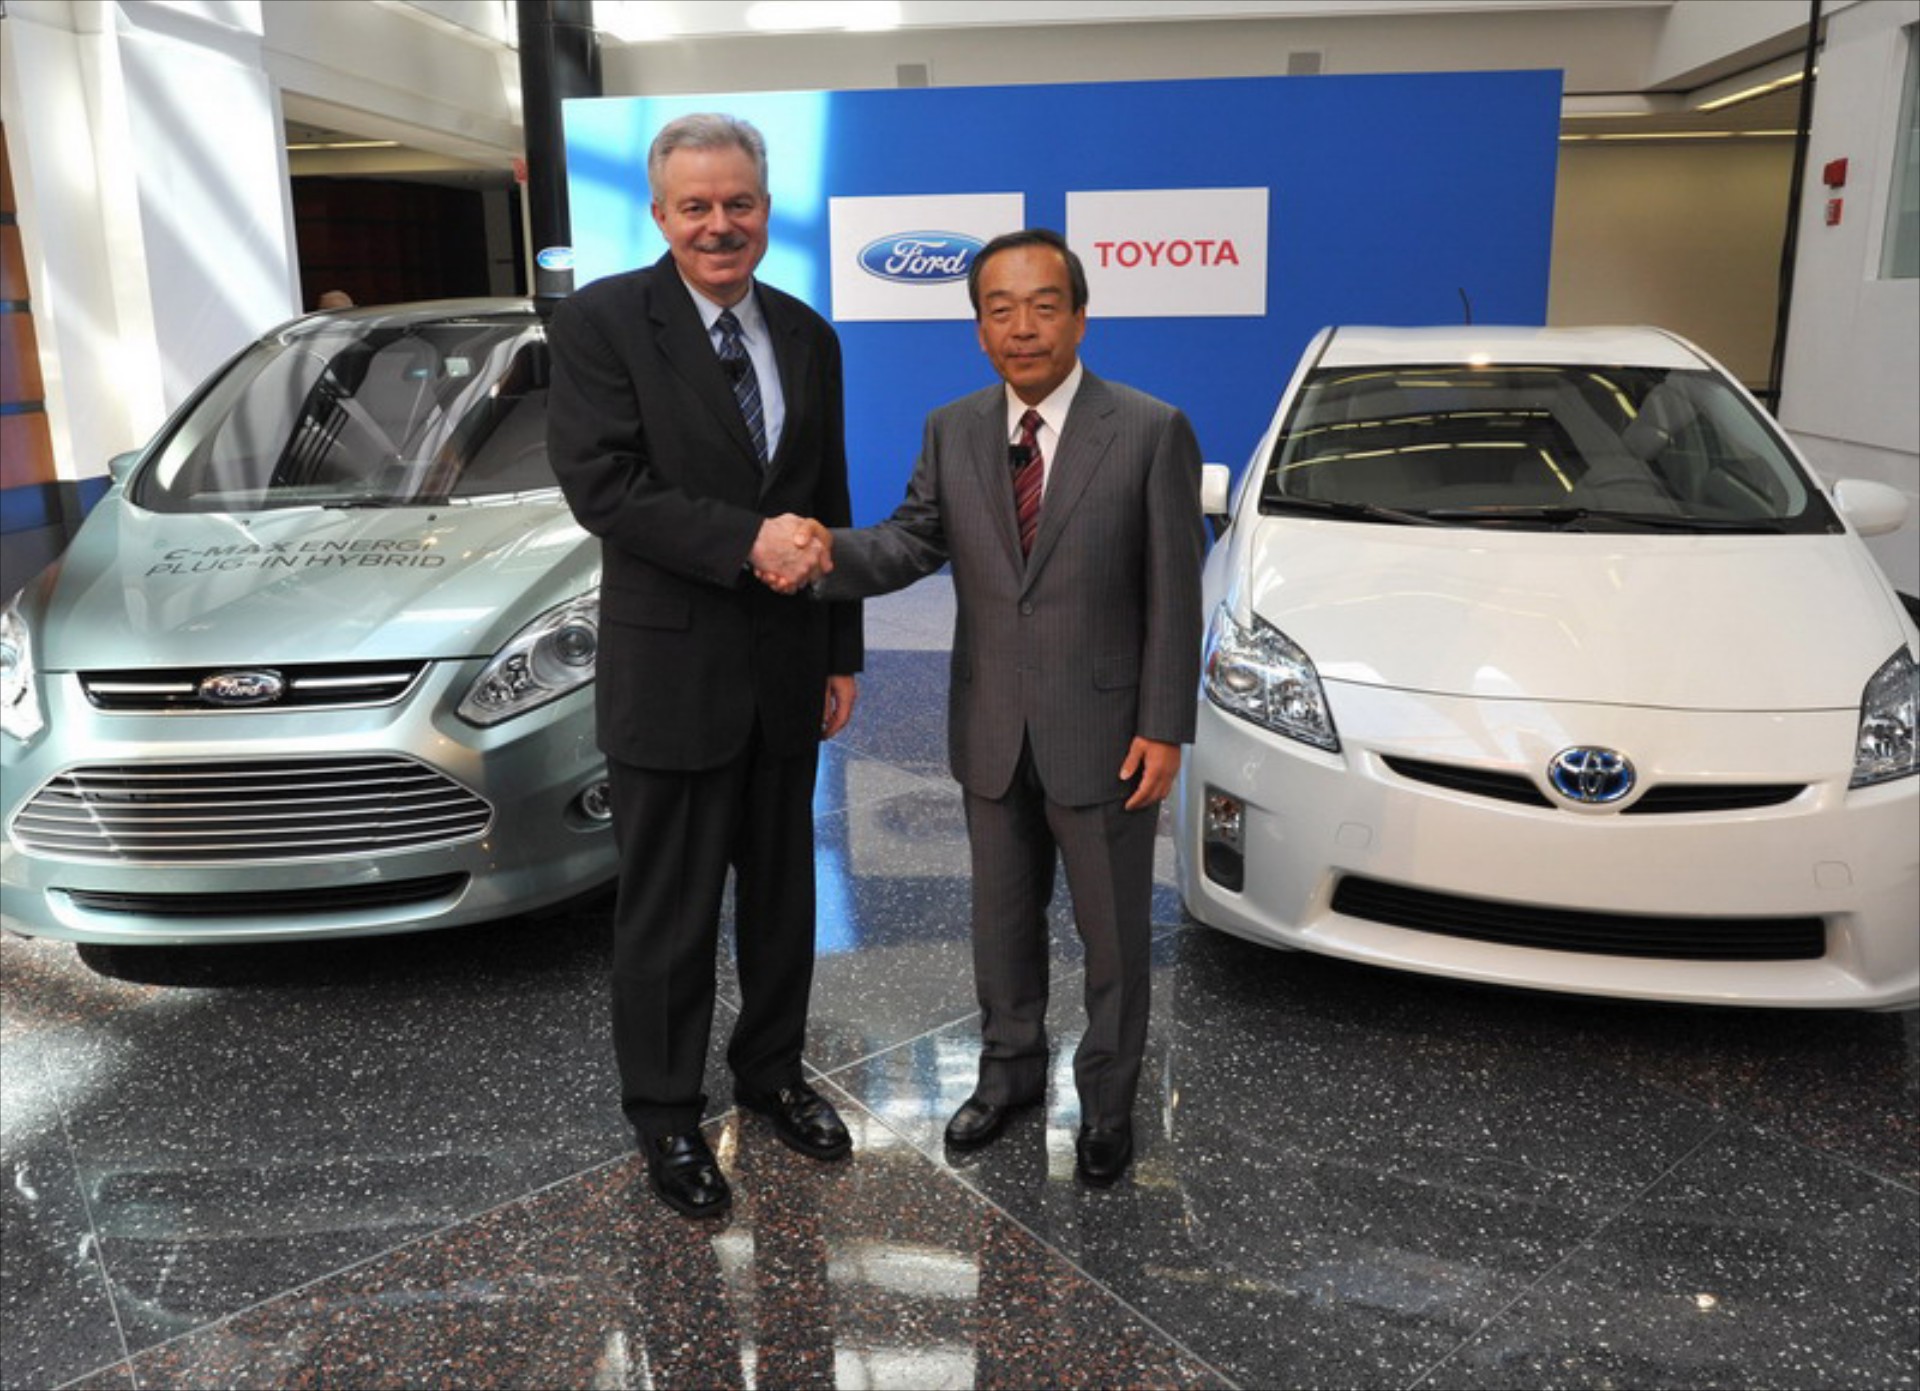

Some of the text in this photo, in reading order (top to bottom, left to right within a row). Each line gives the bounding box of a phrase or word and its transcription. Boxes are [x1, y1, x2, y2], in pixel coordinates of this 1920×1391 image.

[885, 239, 968, 274] Ford
[1094, 239, 1240, 268] TOYOTA
[164, 542, 294, 560] C-MAX
[145, 553, 446, 577] PLUG-IN HYBRID
